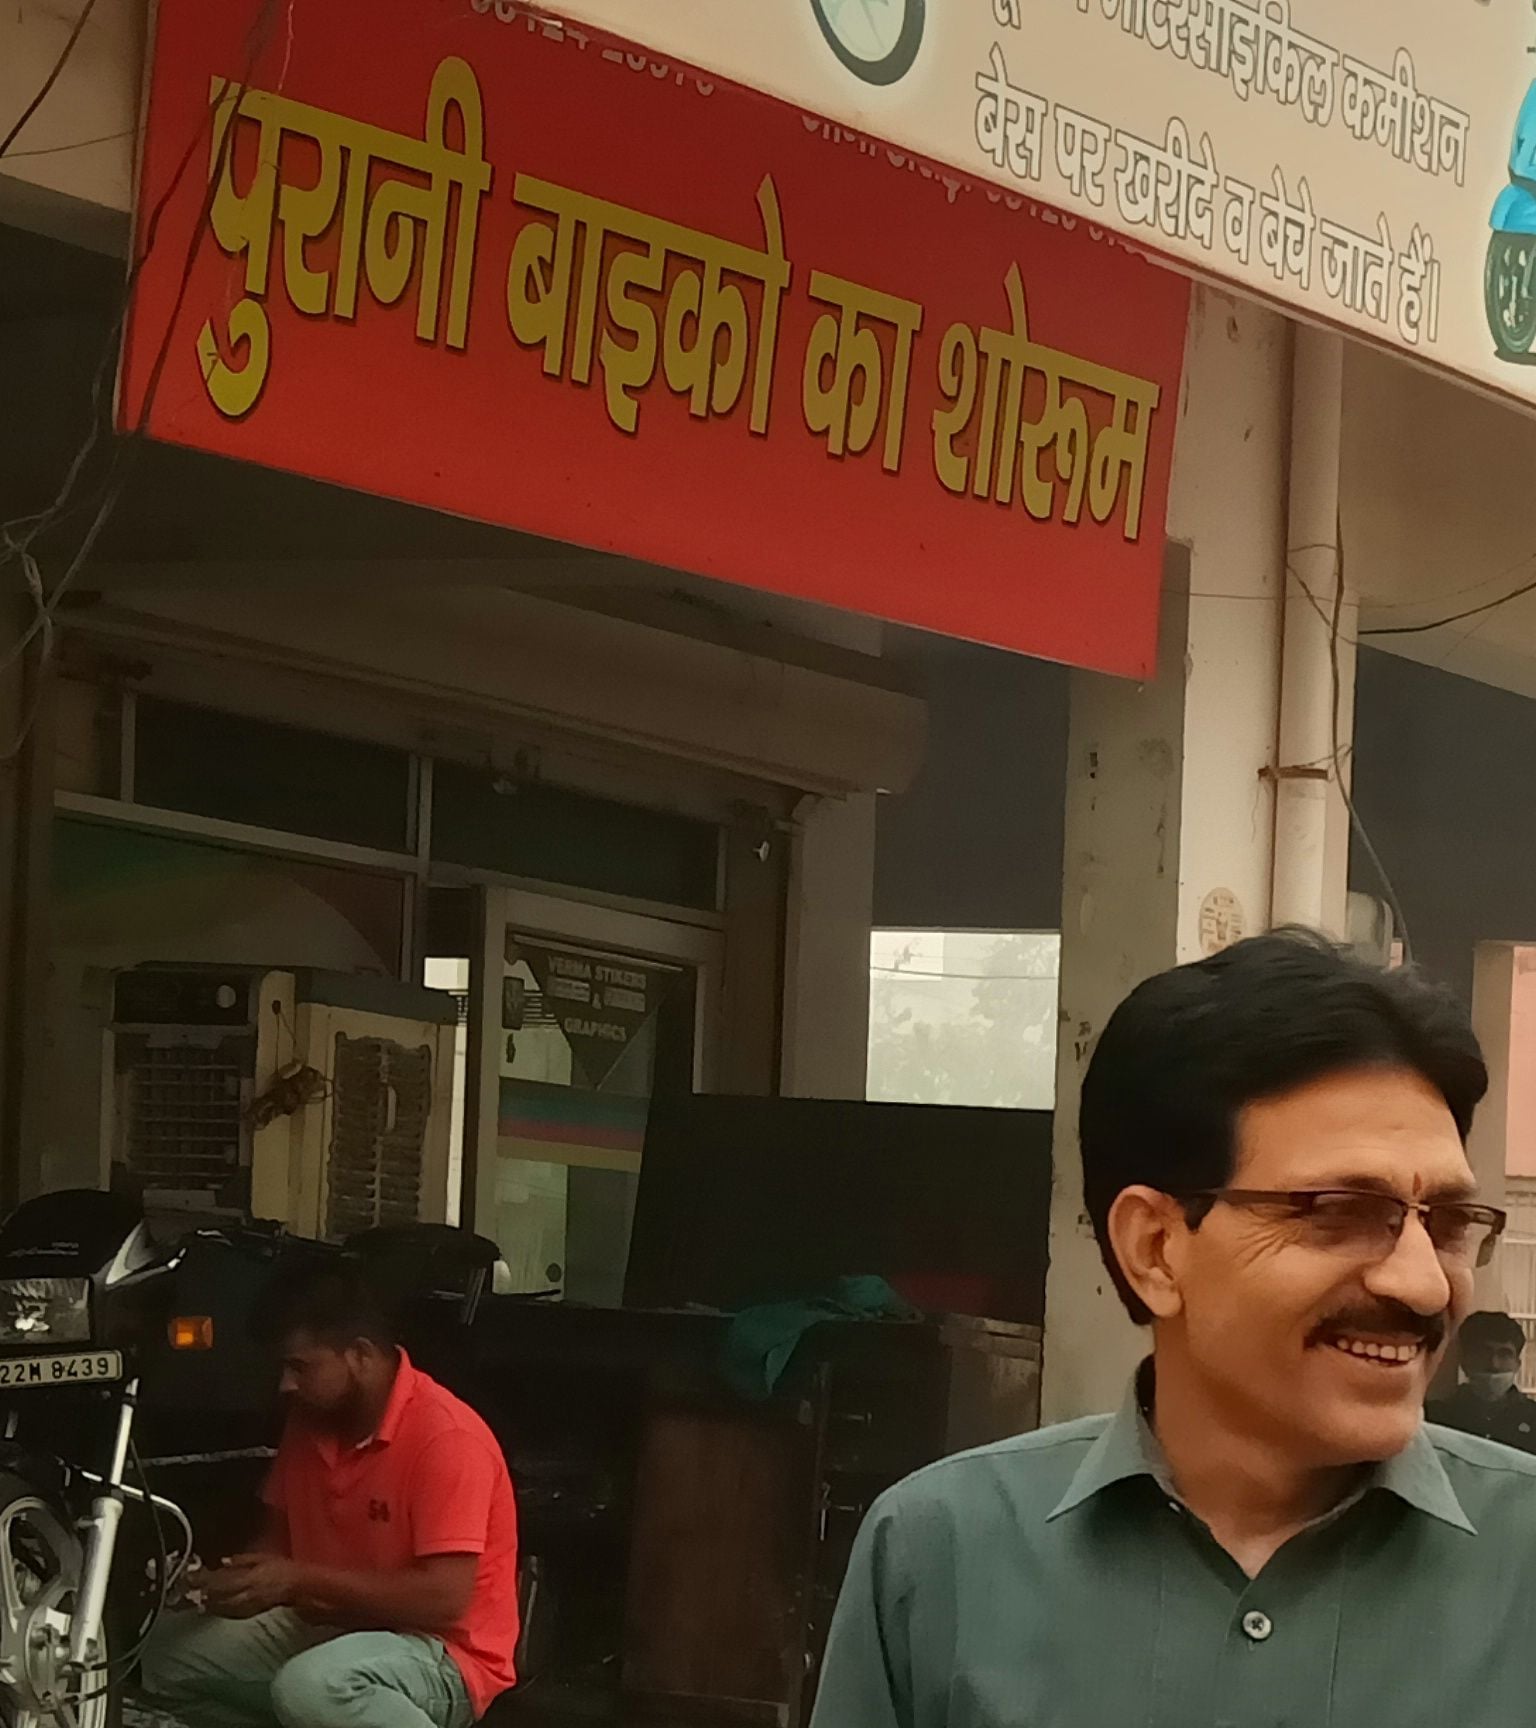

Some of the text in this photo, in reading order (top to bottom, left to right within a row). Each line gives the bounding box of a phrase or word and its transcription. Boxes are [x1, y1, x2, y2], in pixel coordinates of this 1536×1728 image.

[975, 41, 1048, 180] बेस
[1053, 103, 1111, 207] पर
[1224, 175, 1255, 265] व
[1260, 164, 1316, 290] बेचे
[1321, 211, 1393, 323] जाते
[1342, 47, 1470, 187] कमीशन
[199, 56, 492, 418] पुरानी
[506, 174, 791, 433] बाइको
[804, 271, 922, 471] का
[934, 261, 1162, 540] शोरूम
